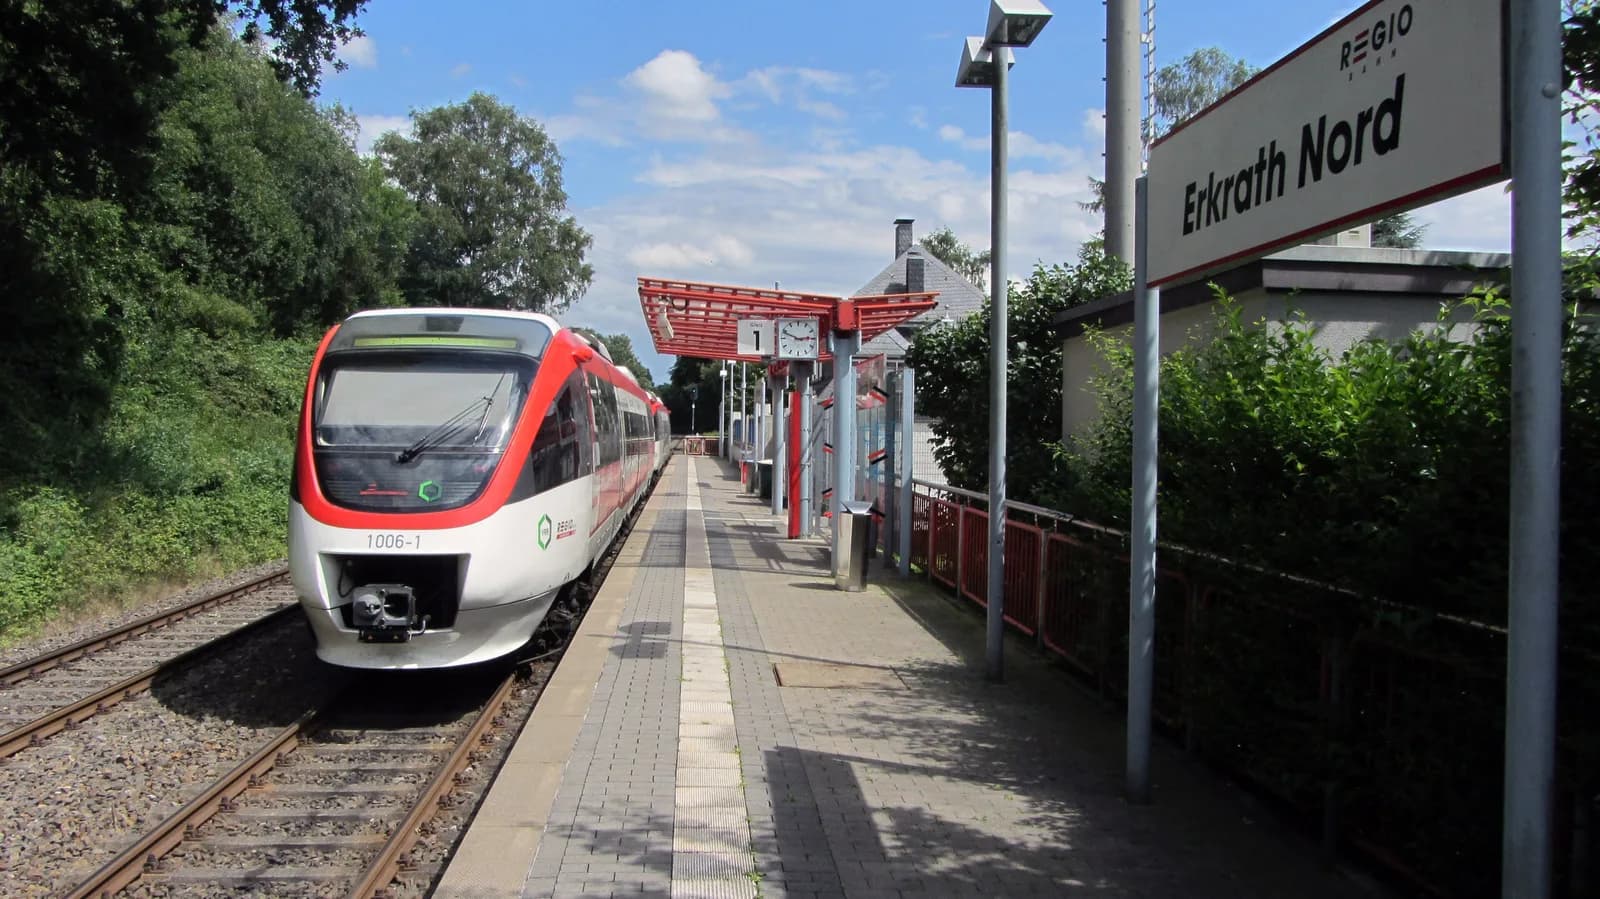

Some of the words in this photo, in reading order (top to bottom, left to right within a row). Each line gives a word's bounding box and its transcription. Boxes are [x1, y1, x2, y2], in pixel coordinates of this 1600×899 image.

[1340, 4, 1413, 71] REGIO
[1182, 140, 1286, 237] Erkrath
[1298, 73, 1406, 189] Nord
[753, 330, 760, 351] 1
[367, 534, 421, 549] 1006-1
